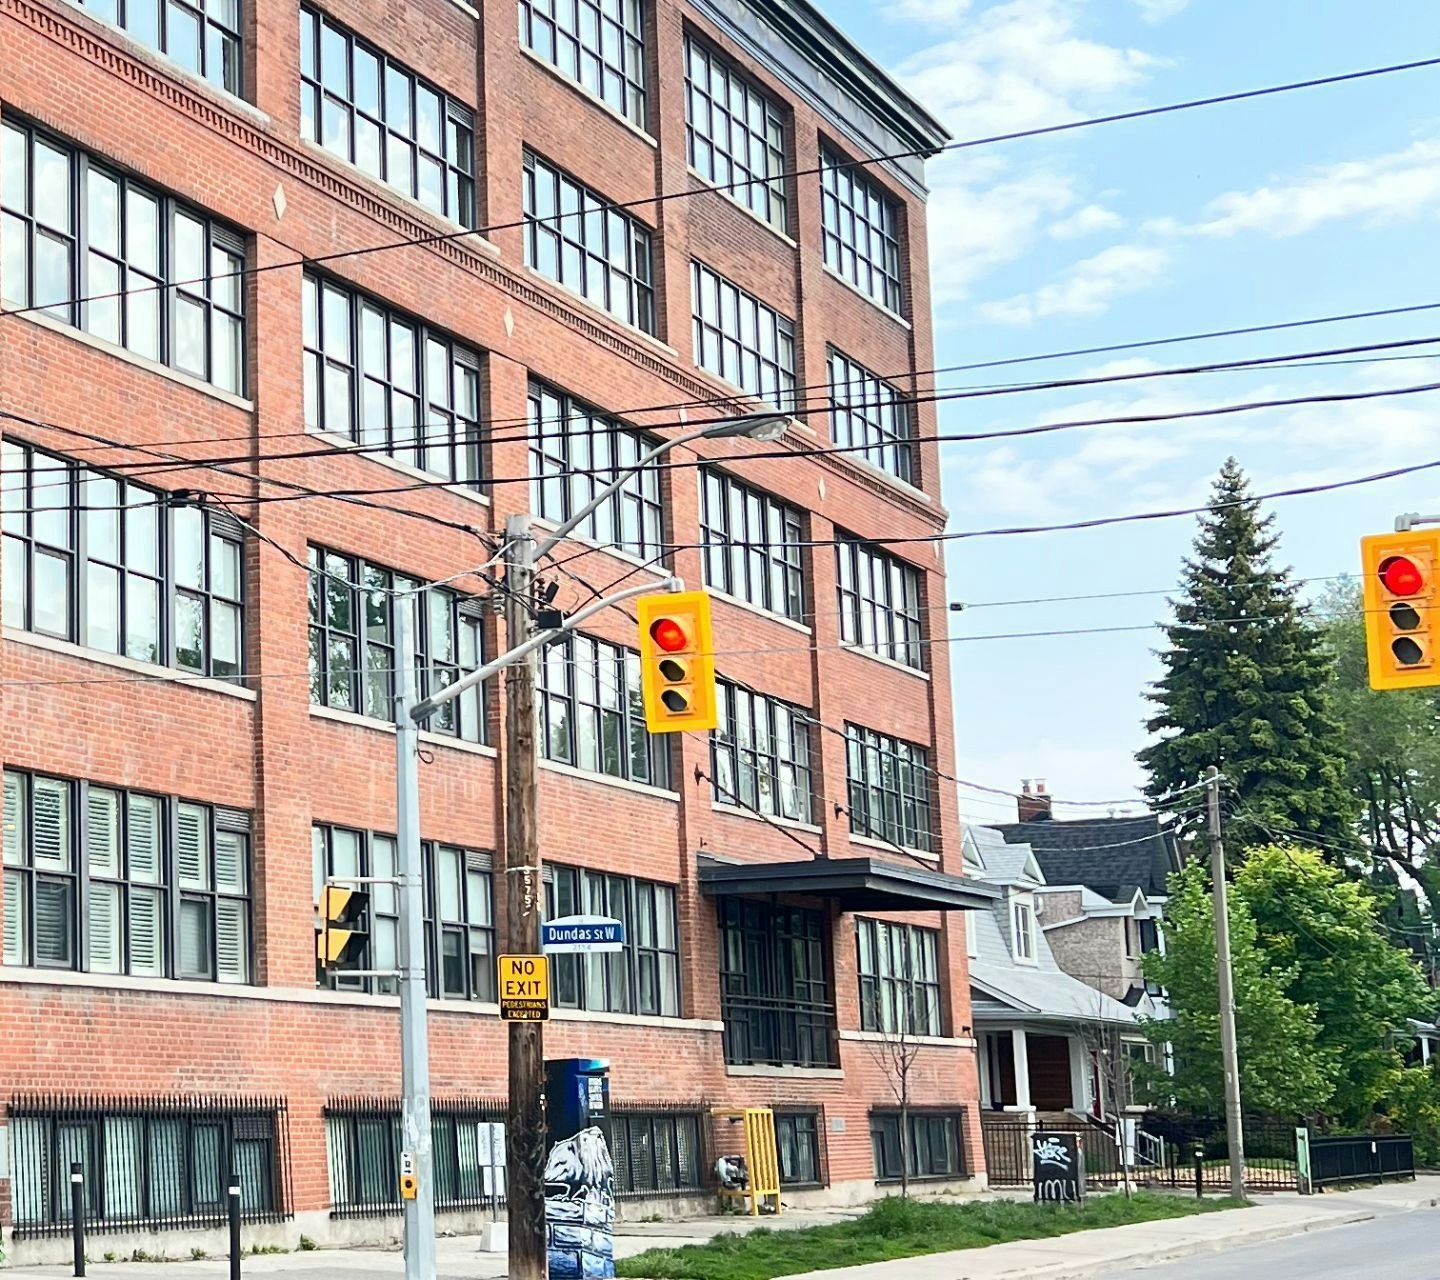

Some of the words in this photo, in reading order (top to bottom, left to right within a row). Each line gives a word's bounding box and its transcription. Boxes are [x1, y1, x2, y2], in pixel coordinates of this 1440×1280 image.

[549, 927, 591, 941] Dundas
[594, 929, 603, 940] St
[605, 926, 615, 940] W
[512, 960, 535, 976] NO
[506, 980, 541, 996] EXIT
[502, 1000, 546, 1009] PEDESTRIANS
